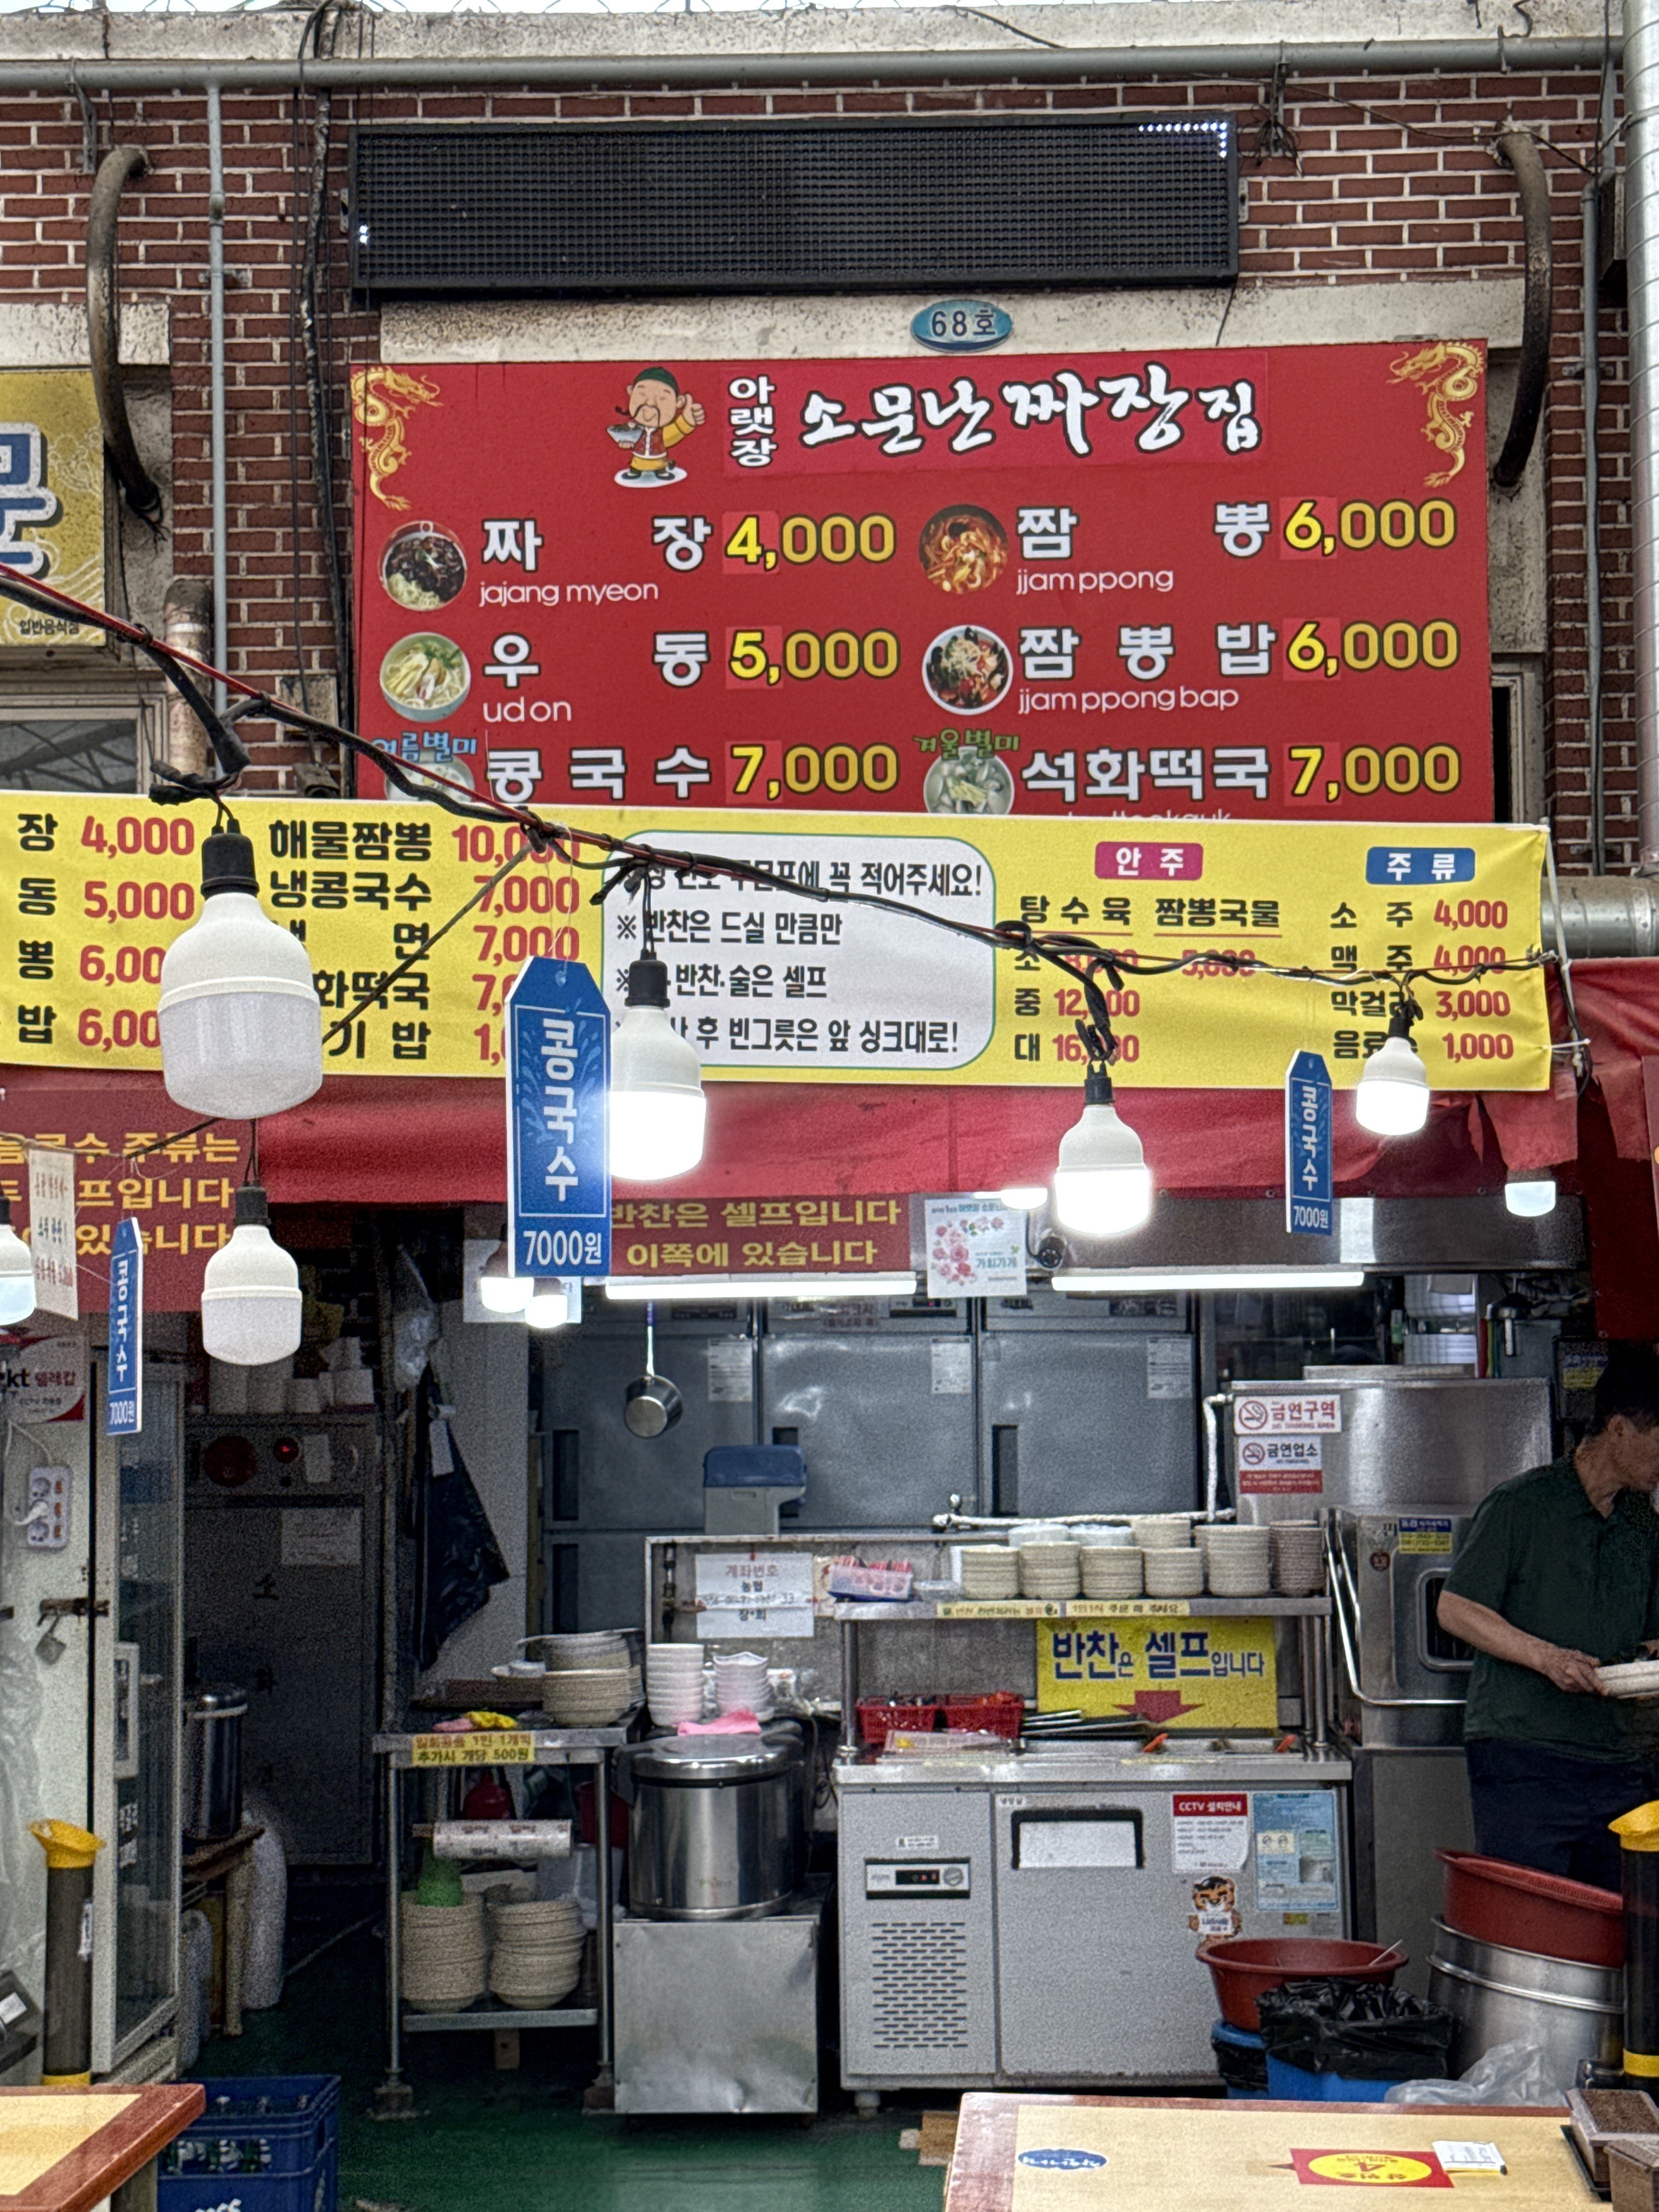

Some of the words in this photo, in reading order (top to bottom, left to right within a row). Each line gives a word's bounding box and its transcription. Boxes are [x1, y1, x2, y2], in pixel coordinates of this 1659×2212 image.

[931, 308, 997, 337] 68호
[729, 375, 775, 467] 아랫장
[800, 376, 992, 455] 소문난
[1002, 363, 1263, 456] 짜장집
[726, 514, 895, 571] 4,000
[1283, 498, 1458, 557] 6,000
[479, 580, 560, 607] jajang
[566, 582, 658, 606] myeon
[729, 629, 900, 686] 5,000
[1286, 618, 1460, 678] 6,000
[483, 697, 572, 723] udon
[370, 731, 477, 763] 여름별미
[913, 728, 1020, 761] 겨울별미
[731, 743, 899, 800] 7,000
[1020, 747, 1271, 803] 석화떡국
[1288, 744, 1462, 802] 7,000
[18, 813, 59, 851] 장
[81, 815, 195, 859] 4,000
[269, 819, 432, 861] 해물짬뽕
[828, 861, 851, 893] 꼭
[860, 862, 982, 896] 적어주세요!
[1116, 847, 1185, 877] 안주
[1386, 853, 1457, 881] 주류
[18, 878, 58, 916] 동
[84, 881, 195, 923] 5,000
[270, 870, 432, 911] 냉콩국수
[473, 875, 580, 918] 7,000
[720, 911, 765, 945] 드실
[775, 911, 842, 945] 만큼만
[1020, 895, 1131, 926] 탕수육
[1154, 897, 1280, 929] 짬뽕국물
[1433, 899, 1508, 931] 4,000
[18, 939, 54, 980] 뽕
[80, 944, 167, 987] 6,00
[473, 924, 580, 968] 7,000
[1433, 944, 1506, 974] 4,000
[313, 969, 431, 1010] 화떡국
[782, 966, 828, 998] 셀프
[1014, 988, 1041, 1017] 중
[1053, 988, 1141, 1020] 12,00
[1435, 989, 1511, 1022] 3,000
[18, 1004, 57, 1044] 밥
[77, 1008, 161, 1052] 6,00
[696, 1016, 719, 1050] 후
[729, 1017, 819, 1052] 빈그릇은
[828, 1020, 850, 1053] 앞
[859, 1020, 958, 1054] 싱크대로!
[1014, 1032, 1041, 1062] 대
[1442, 1032, 1514, 1064] 1,000
[540, 1017, 580, 1203] 콩국수
[1301, 1085, 1319, 1192] 콩국수
[76, 1177, 235, 1210] 프입니다
[611, 1203, 709, 1229] 반찬은
[720, 1199, 901, 1228] 셀프입니다
[1293, 1205, 1329, 1229] 7000원
[76, 1222, 232, 1256] 있니다
[523, 1230, 602, 1266] 7000원
[627, 1242, 729, 1269] 이쪽에
[742, 1239, 878, 1268] 있습니다
[116, 1259, 129, 1383] 콩국수
[1270, 1400, 1335, 1421] 금연구역
[1267, 1442, 1319, 1458] 금연업소
[1053, 1629, 1135, 1680] 반찬은
[1144, 1631, 1266, 1679] 셀프입니다
[492, 1747, 529, 1761] 500원
[1178, 1801, 1205, 1812] CCTV
